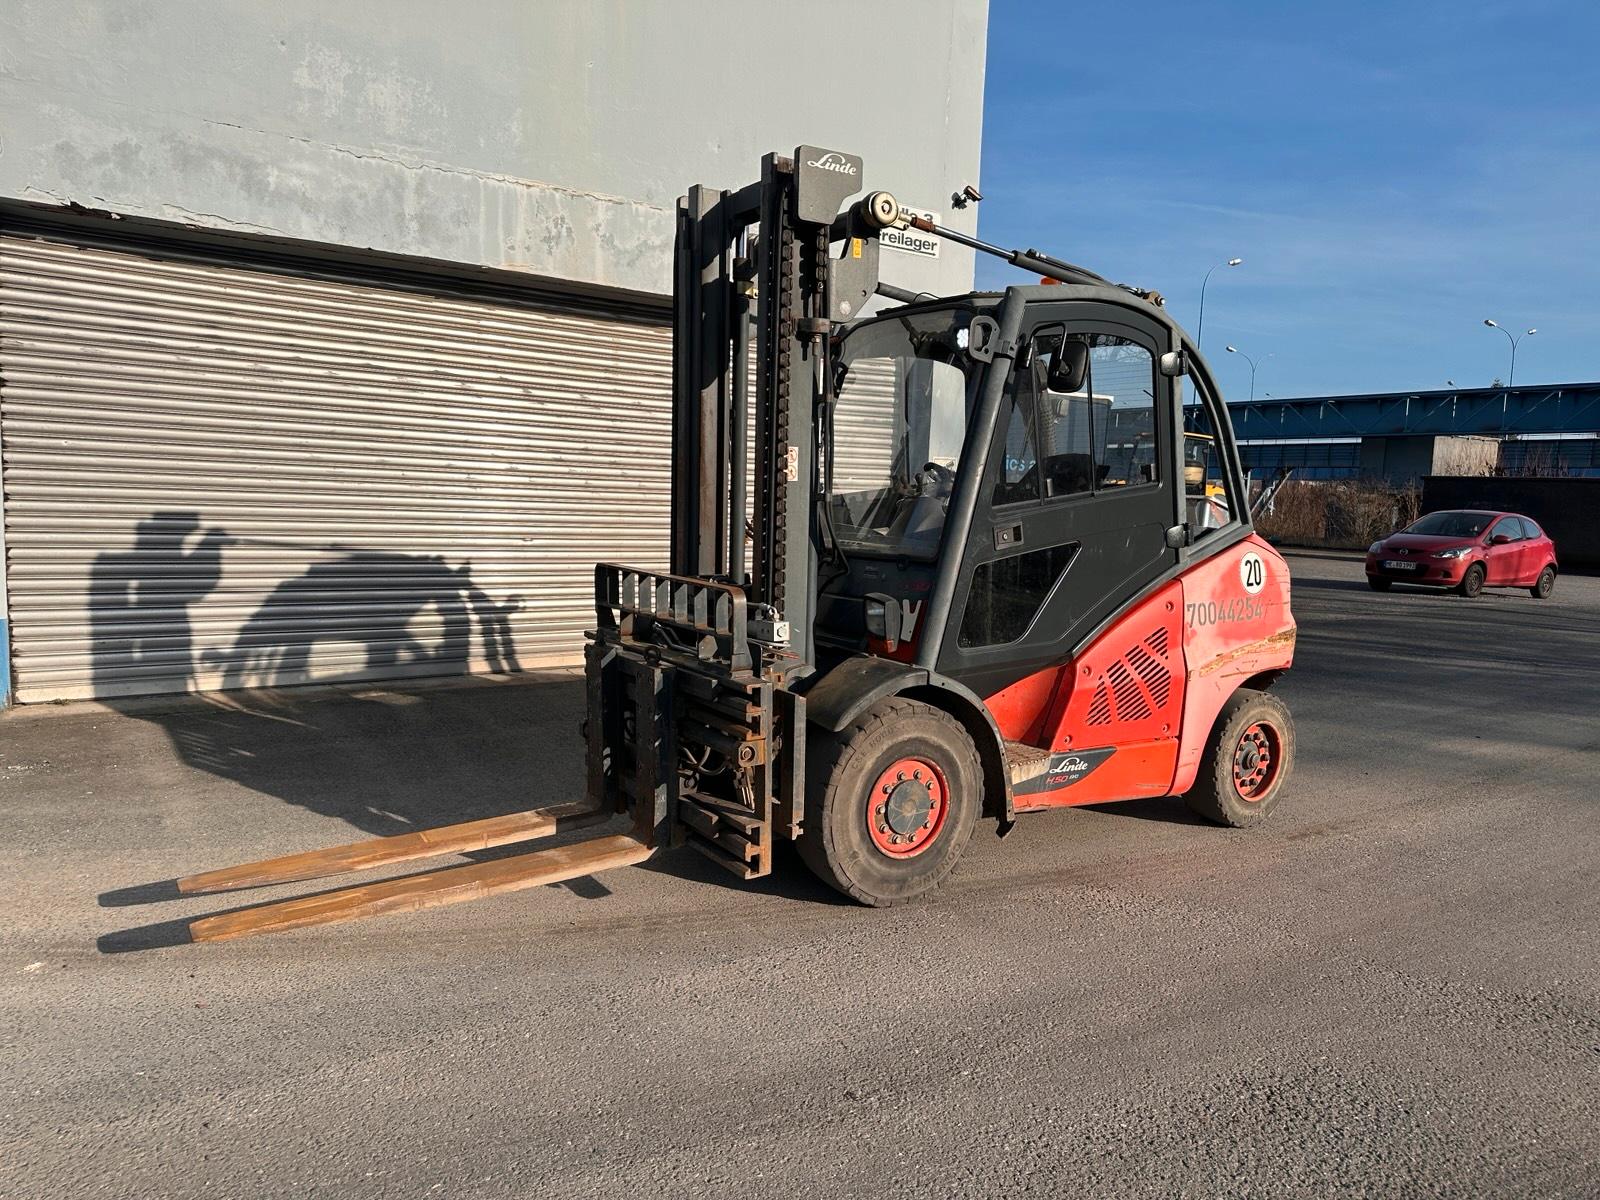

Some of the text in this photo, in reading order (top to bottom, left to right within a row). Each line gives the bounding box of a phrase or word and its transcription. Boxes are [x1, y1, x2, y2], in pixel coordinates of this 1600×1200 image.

[807, 153, 857, 176] Linde
[880, 231, 938, 251] reilager
[1245, 559, 1262, 587] 20
[1186, 597, 1263, 628] 70044254
[1049, 757, 1088, 774] Linde
[1046, 775, 1069, 785] H50
